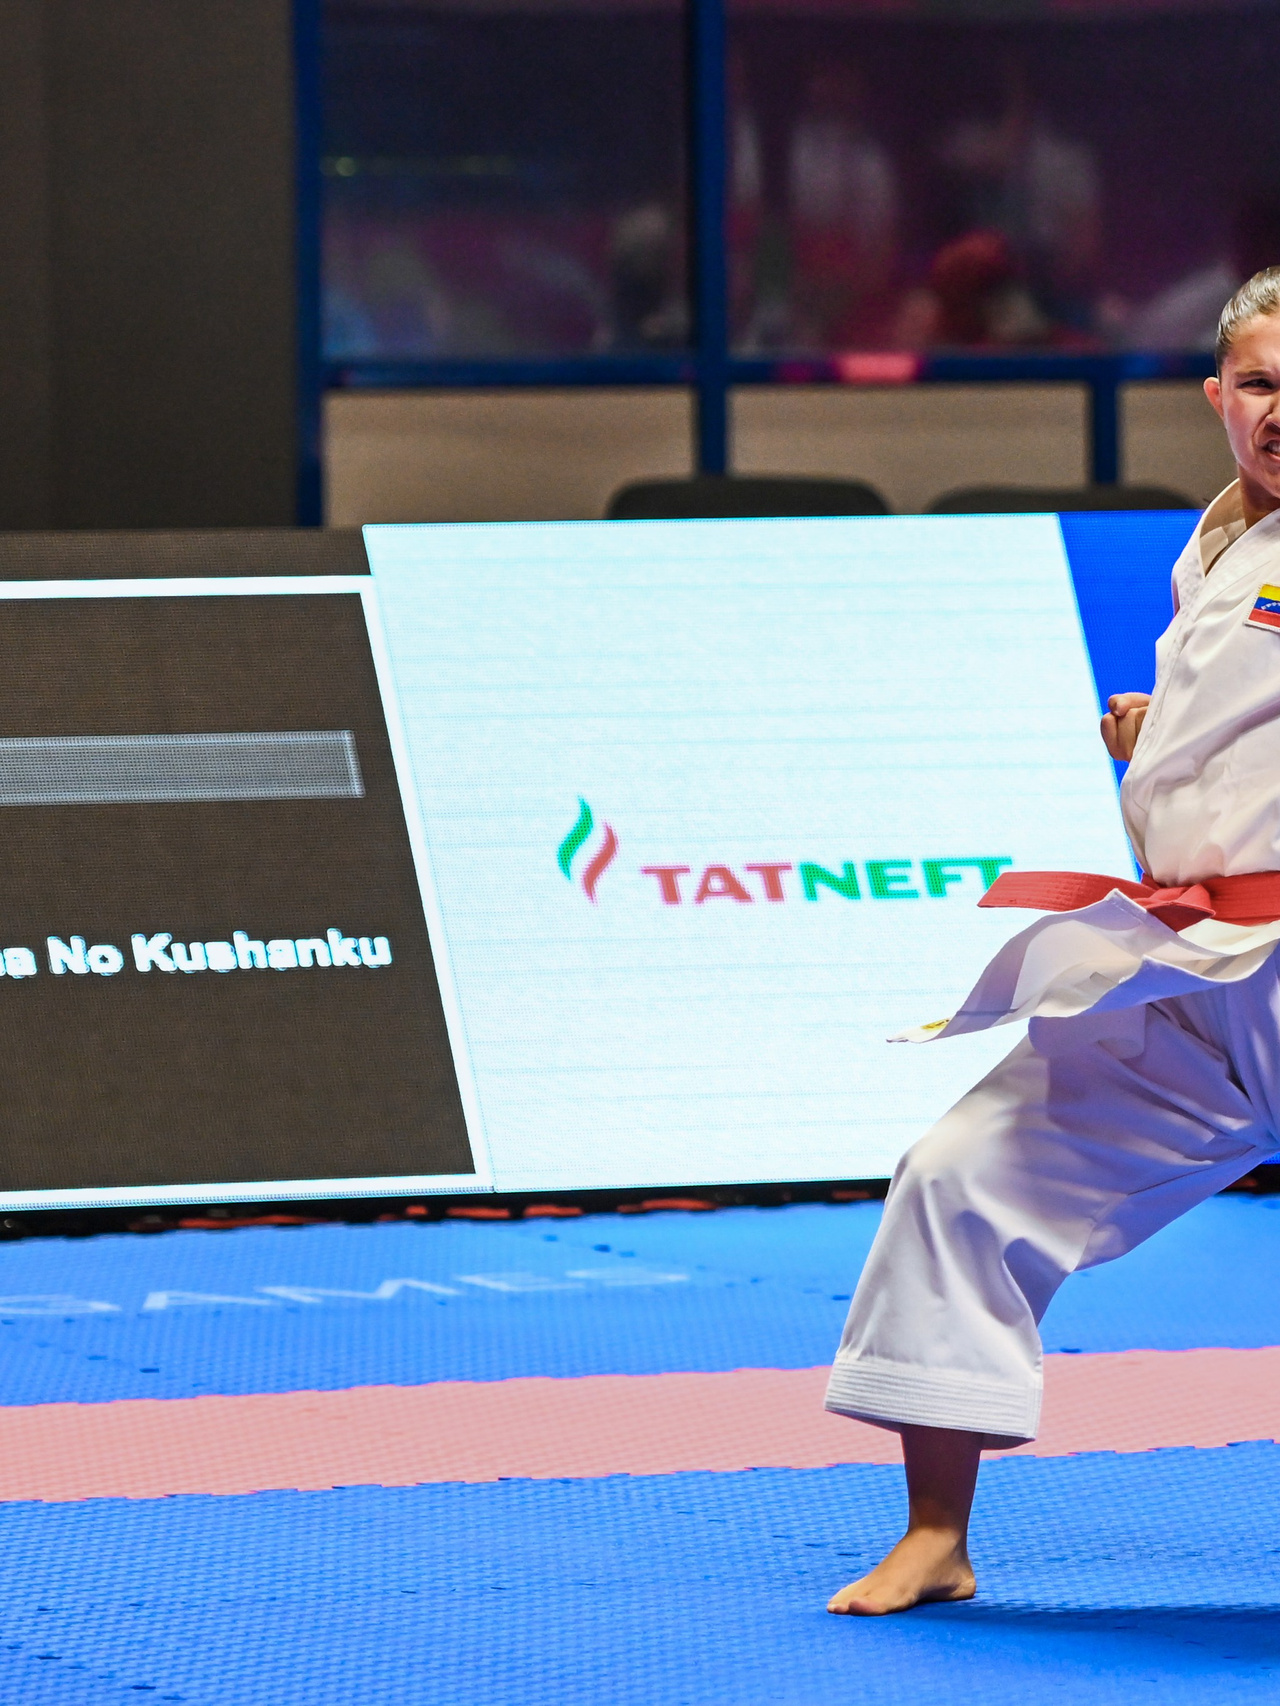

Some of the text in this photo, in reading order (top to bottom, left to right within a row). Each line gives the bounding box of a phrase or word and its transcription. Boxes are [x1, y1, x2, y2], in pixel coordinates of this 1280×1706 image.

[641, 855, 1013, 905] TATNEFT
[46, 934, 124, 977] No
[131, 927, 393, 974] Kushanku
